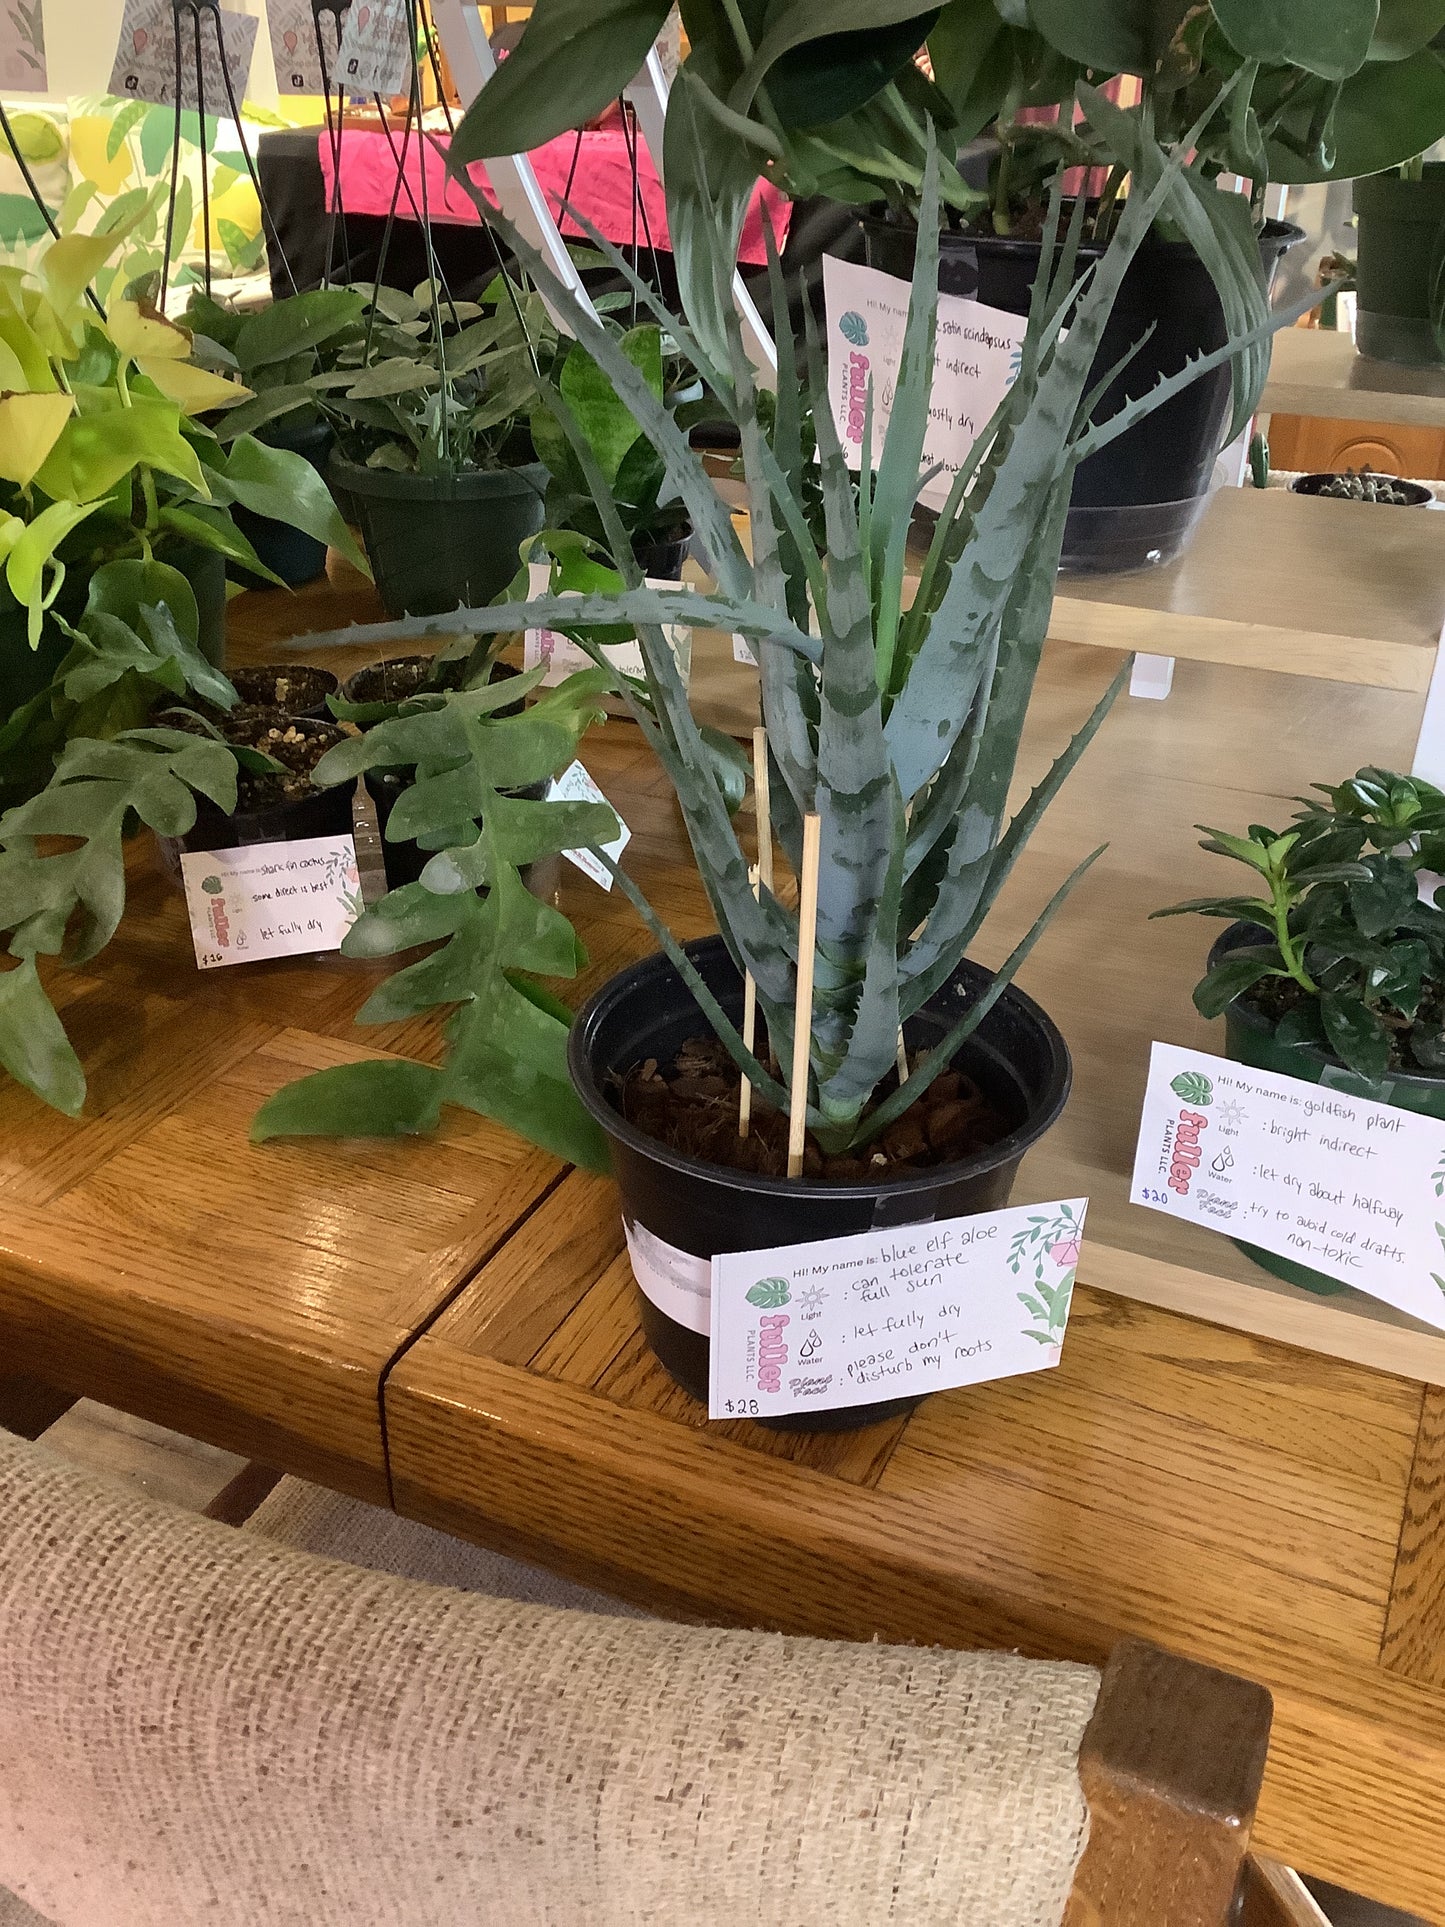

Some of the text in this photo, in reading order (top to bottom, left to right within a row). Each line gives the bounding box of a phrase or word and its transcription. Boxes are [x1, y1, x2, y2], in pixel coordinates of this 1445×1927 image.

[879, 301, 892, 315] My
[942, 320, 962, 336] satin
[841, 362, 849, 402] PLANTS
[945, 357, 982, 379] indirect
[957, 413, 975, 435] dry
[286, 860, 298, 872] fin
[252, 880, 329, 903] some direct is best
[260, 918, 323, 941] let fully dry
[1217, 1075, 1232, 1086] Hi!
[1235, 1080, 1253, 1093] My
[1255, 1087, 1287, 1102] name
[1304, 1099, 1356, 1122] goldfish
[1366, 1113, 1407, 1133] plant
[1161, 1118, 1175, 1154] PLANTS
[1218, 1124, 1240, 1137] Light
[1167, 1109, 1209, 1195] fuller
[1319, 1134, 1379, 1159] indirect
[1208, 1169, 1233, 1184] Water
[1141, 1187, 1168, 1205] $20
[1259, 1164, 1404, 1227] let dry about halfway
[1249, 1201, 1269, 1218] try
[1276, 1209, 1290, 1221] to
[1296, 1215, 1328, 1235] avoid
[1330, 1231, 1357, 1245] cold
[812, 1265, 829, 1277] My
[832, 1259, 863, 1272] name
[880, 1244, 918, 1263] blue
[926, 1231, 954, 1251] elf
[961, 1225, 998, 1246] aloe
[1286, 1231, 1364, 1269] non-toxic
[851, 1251, 969, 1291] can tolerate
[859, 1273, 943, 1303] full sun
[800, 1311, 822, 1321] Light
[854, 1304, 961, 1339] let fully dry
[746, 1329, 756, 1362] PLANTS
[757, 1314, 791, 1394] fuller
[847, 1329, 958, 1378] please don't
[797, 1356, 823, 1366] Water
[856, 1338, 993, 1385] disturb my roots
[724, 1398, 760, 1415] $28
